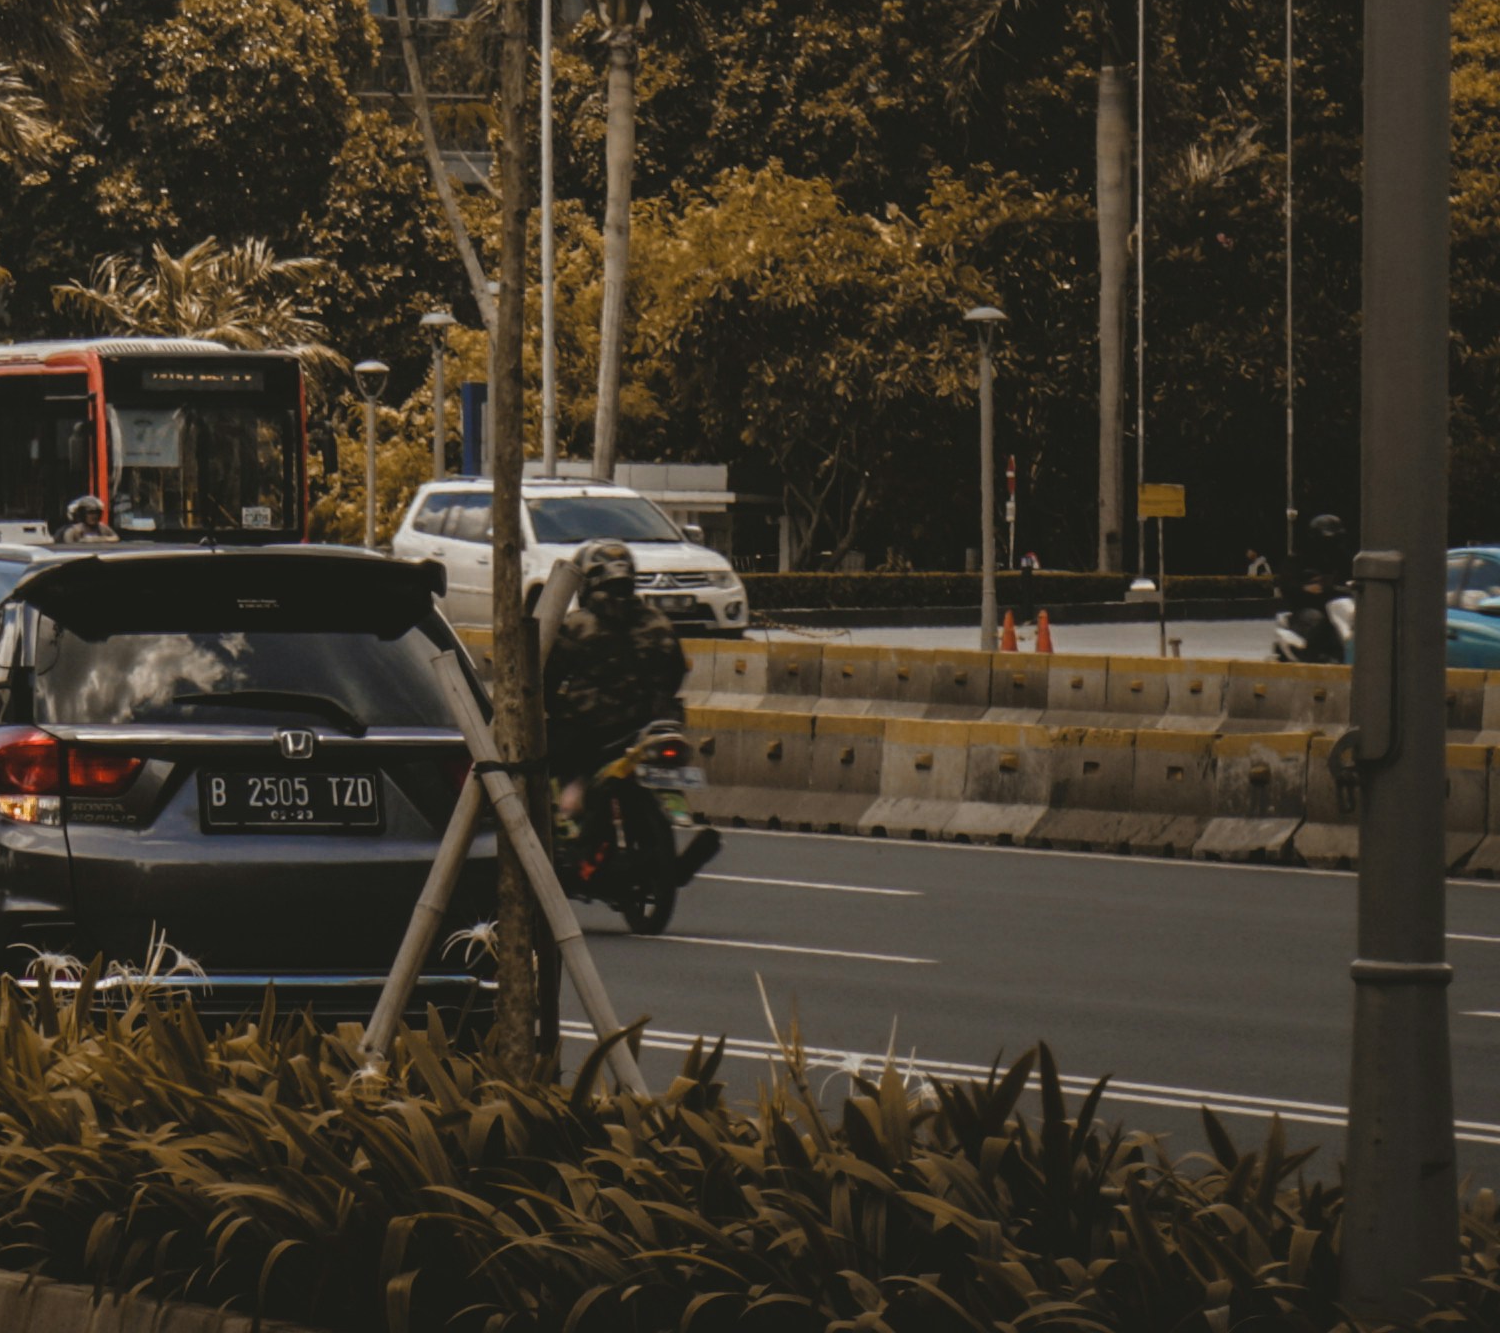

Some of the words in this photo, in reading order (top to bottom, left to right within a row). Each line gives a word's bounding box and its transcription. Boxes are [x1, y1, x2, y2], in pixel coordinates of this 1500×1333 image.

[212, 778, 226, 806] B
[248, 777, 309, 806] 2505
[328, 778, 373, 807] TZD
